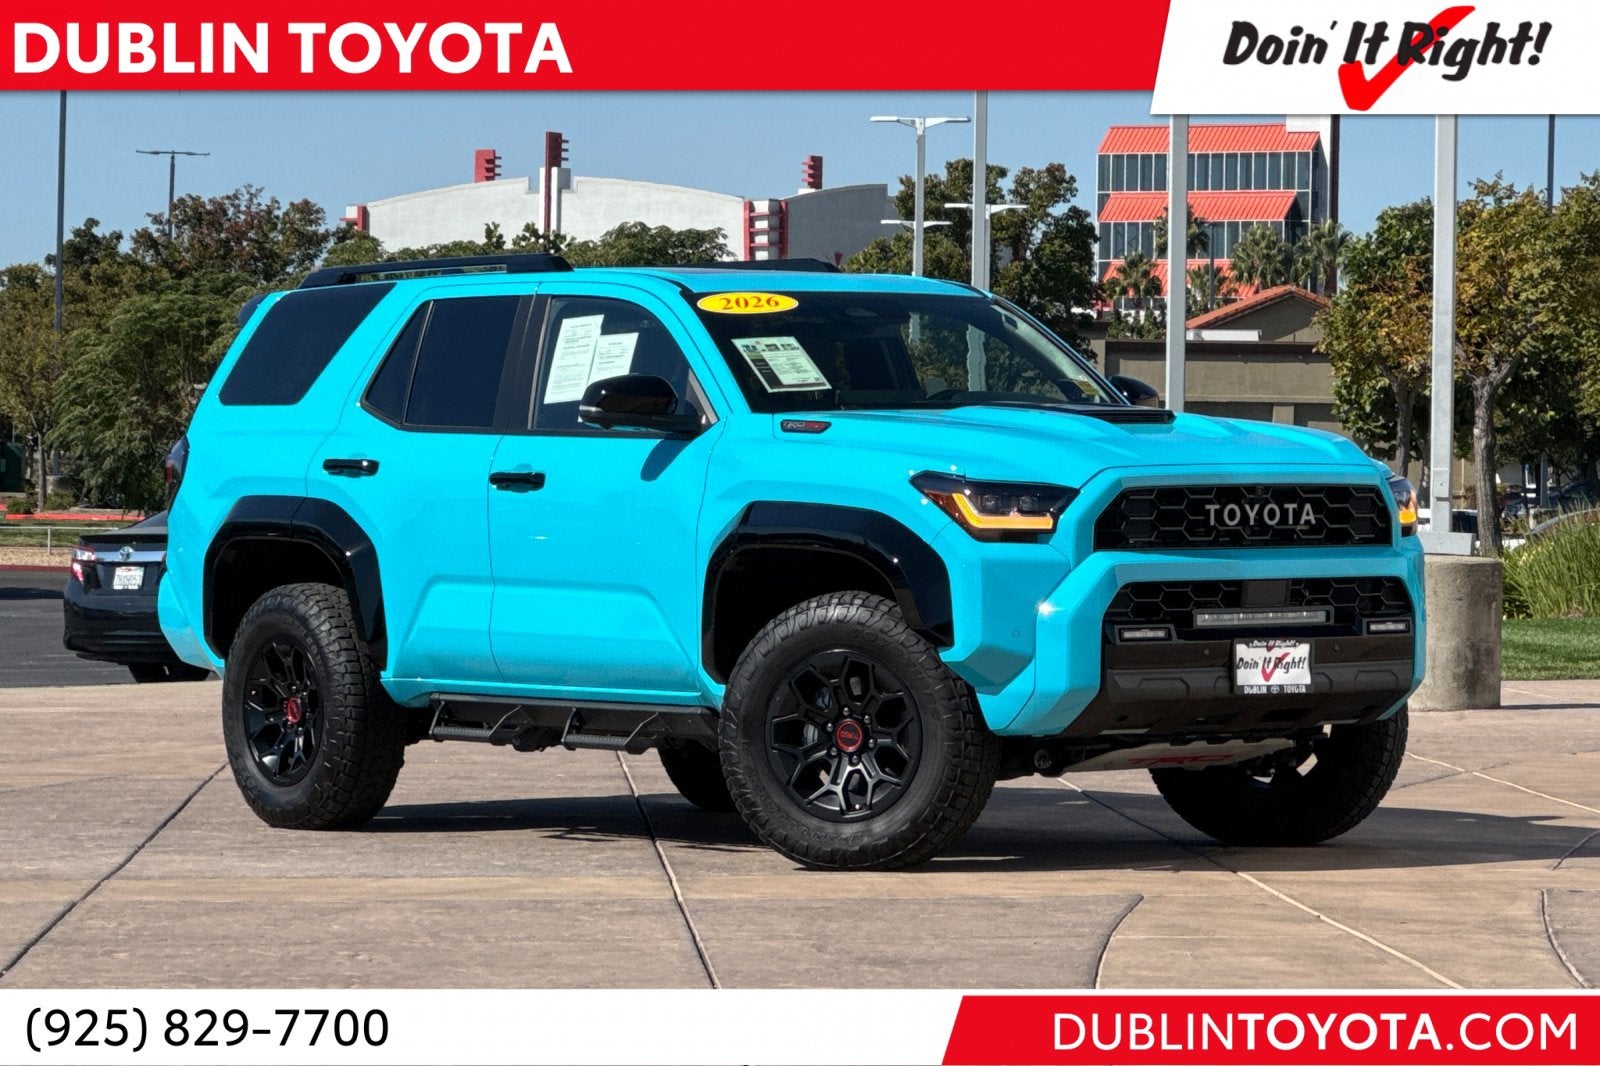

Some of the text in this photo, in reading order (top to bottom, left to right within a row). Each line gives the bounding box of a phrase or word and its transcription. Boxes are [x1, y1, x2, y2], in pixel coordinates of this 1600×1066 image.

[720, 296, 780, 310] 2026
[1205, 503, 1316, 526] TOYOTA
[1263, 656, 1273, 670] It
[1274, 656, 1307, 674] Right!
[1244, 684, 1306, 694] DUBLIN TOYOTA
